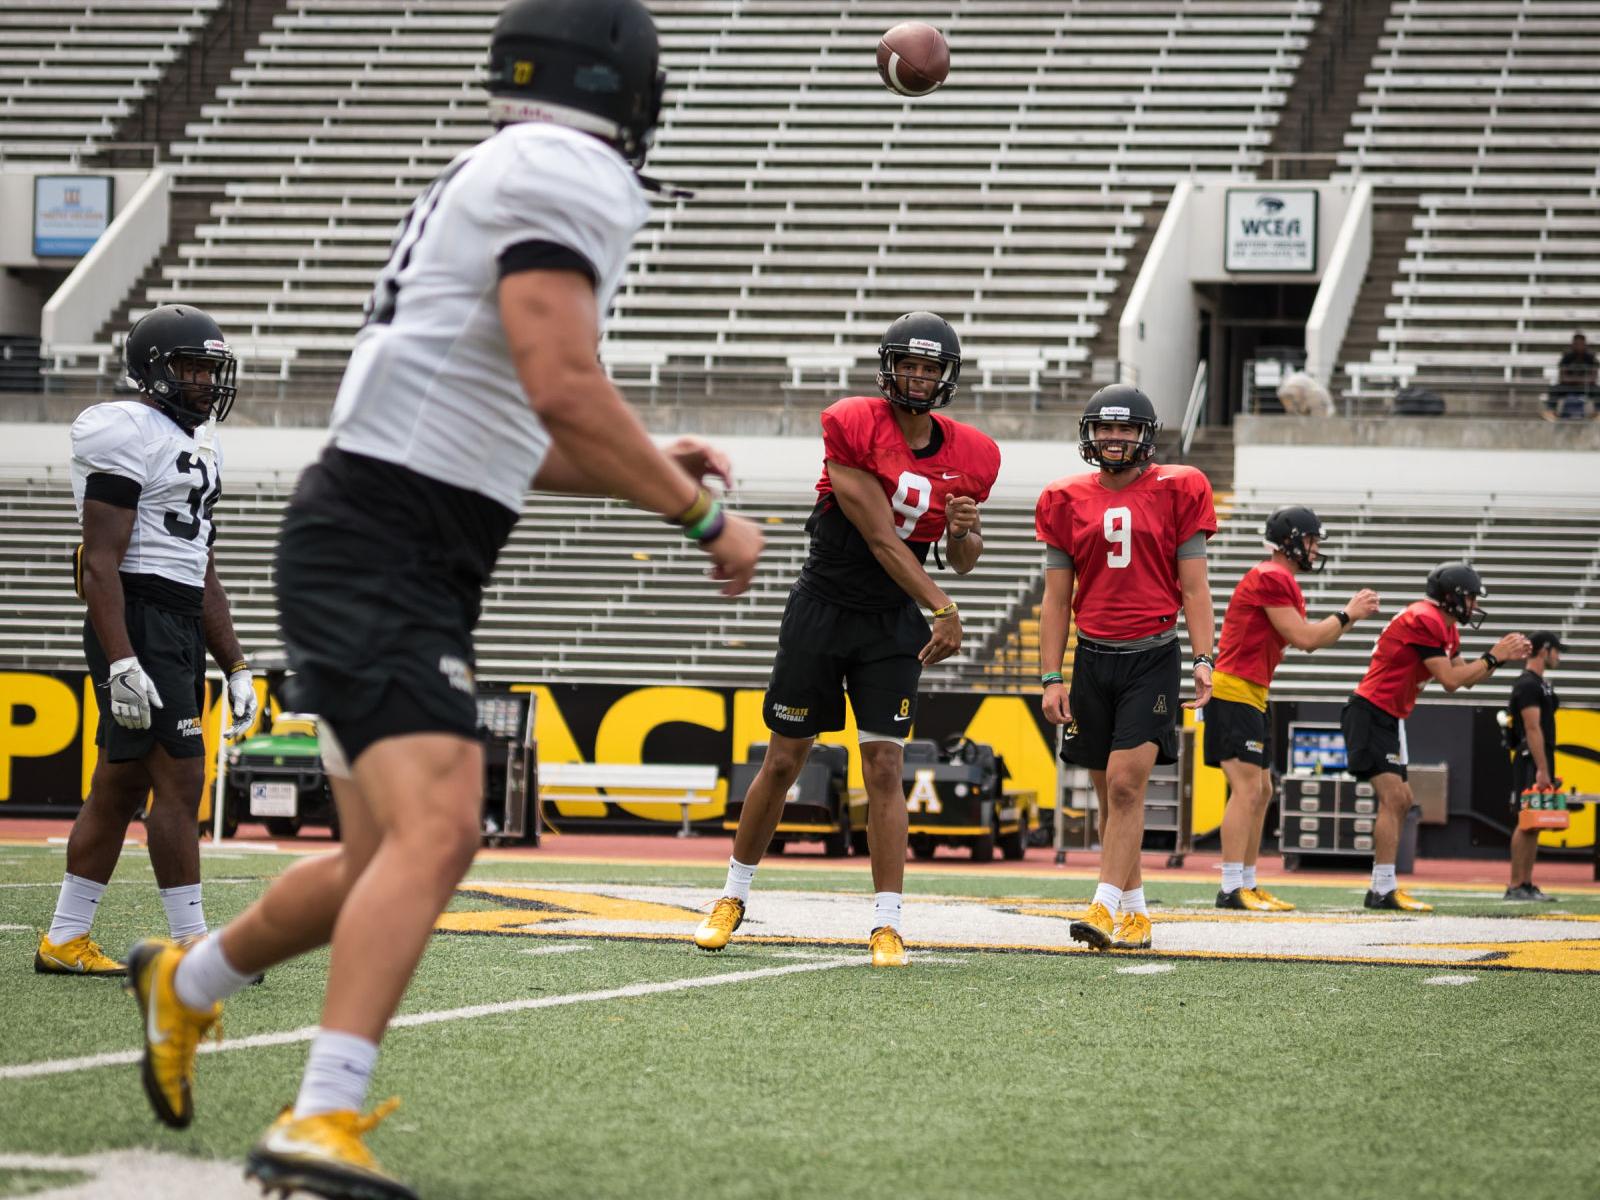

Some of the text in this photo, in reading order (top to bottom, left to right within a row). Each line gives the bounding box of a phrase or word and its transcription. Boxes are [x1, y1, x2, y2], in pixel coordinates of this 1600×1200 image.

[1103, 506, 1132, 569] 9
[775, 711, 805, 723] FOOTBALL
[900, 698, 910, 717] 8
[906, 768, 943, 814] A
